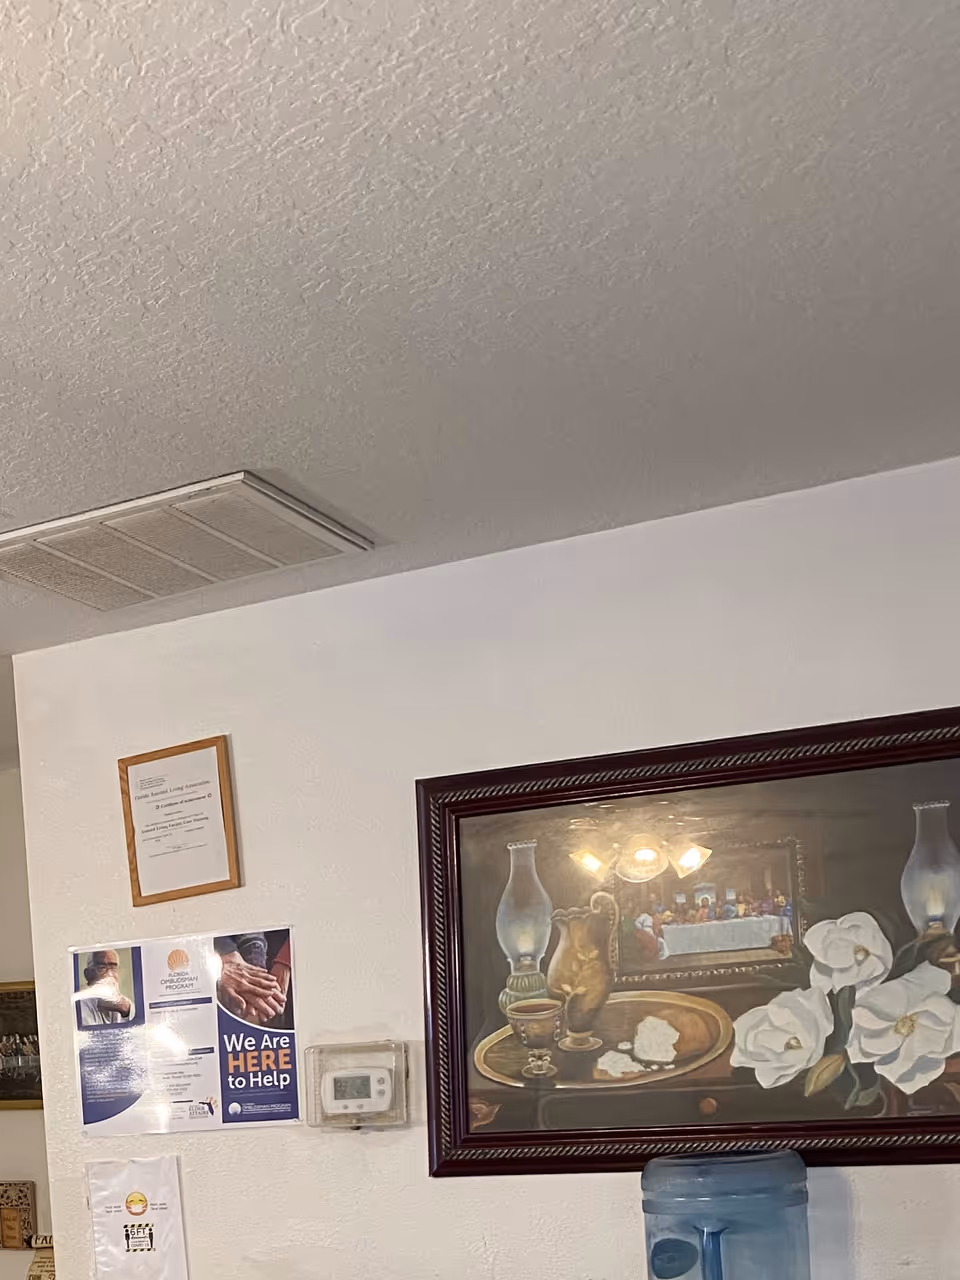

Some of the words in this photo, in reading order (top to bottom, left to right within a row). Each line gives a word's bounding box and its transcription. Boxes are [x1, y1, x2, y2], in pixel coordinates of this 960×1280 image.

[223, 1033, 256, 1052] We
[260, 1034, 290, 1049] Are
[228, 1049, 292, 1073] HERE
[228, 1075, 246, 1089] to
[249, 1071, 291, 1089] Help
